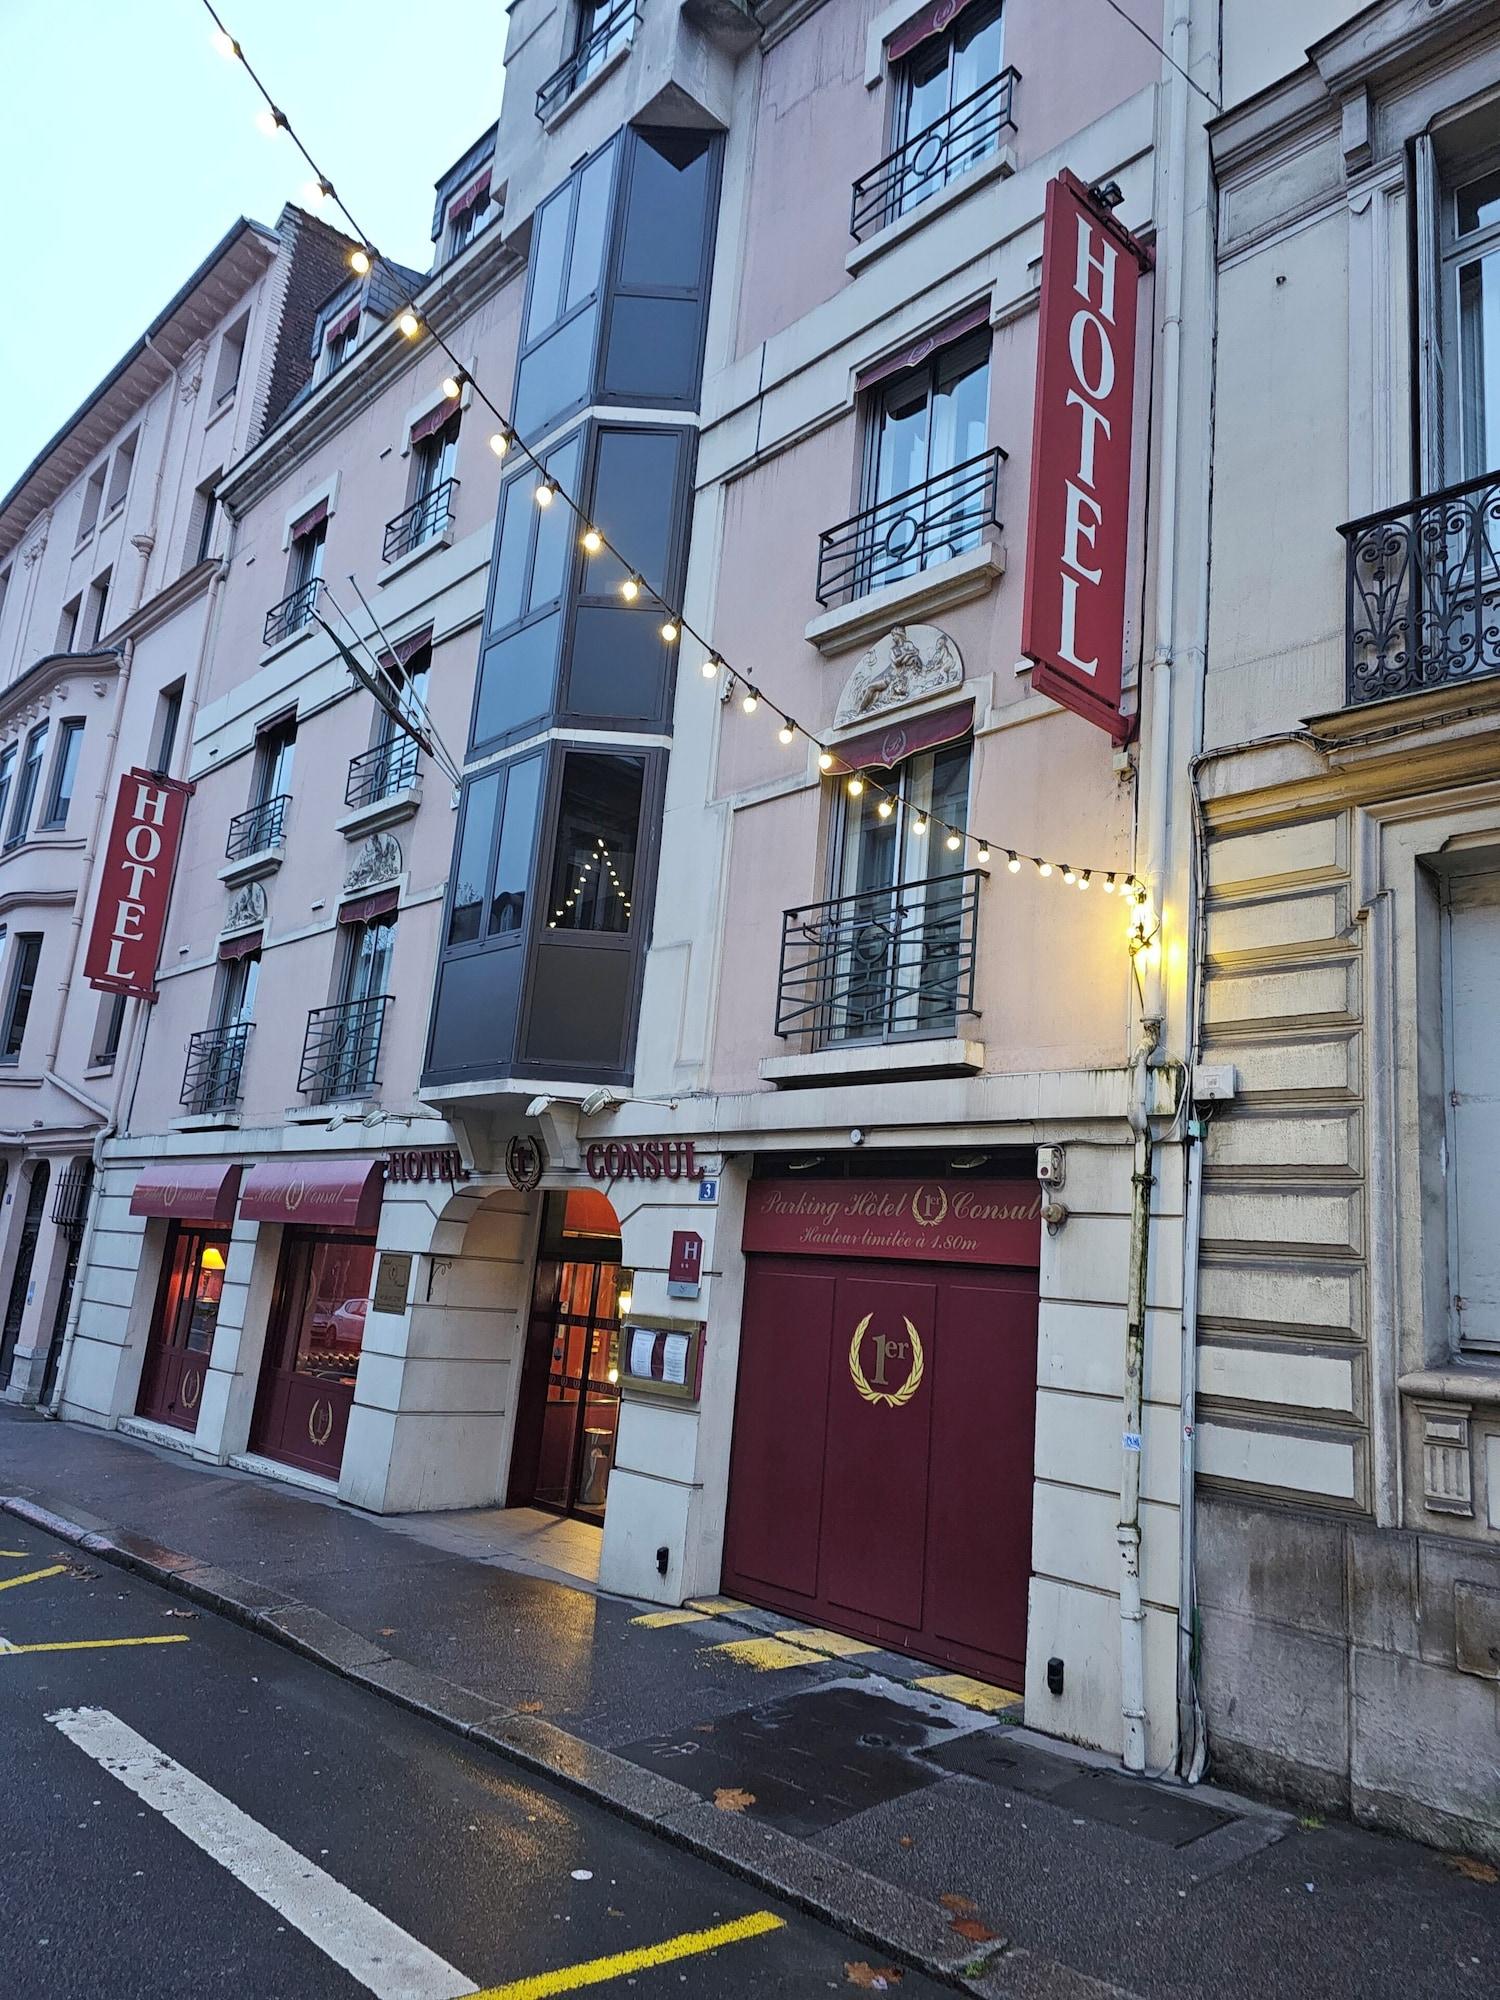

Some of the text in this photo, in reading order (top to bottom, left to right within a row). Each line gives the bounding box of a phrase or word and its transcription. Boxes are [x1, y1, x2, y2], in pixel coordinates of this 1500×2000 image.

[1057, 212, 1119, 677] HOTEL
[104, 784, 169, 980] HOTEL
[387, 1149, 469, 1183] HOTEL
[586, 1141, 705, 1181] CONSUL
[703, 1184, 711, 1198] 3
[761, 1190, 1041, 1226] Parking Hôtel 1er Consul
[683, 1241, 698, 1260] H
[800, 1225, 860, 1245] Hauteur
[915, 1233, 925, 1249] à
[931, 1234, 978, 1250] 1.80m
[869, 1333, 909, 1385] 1er
